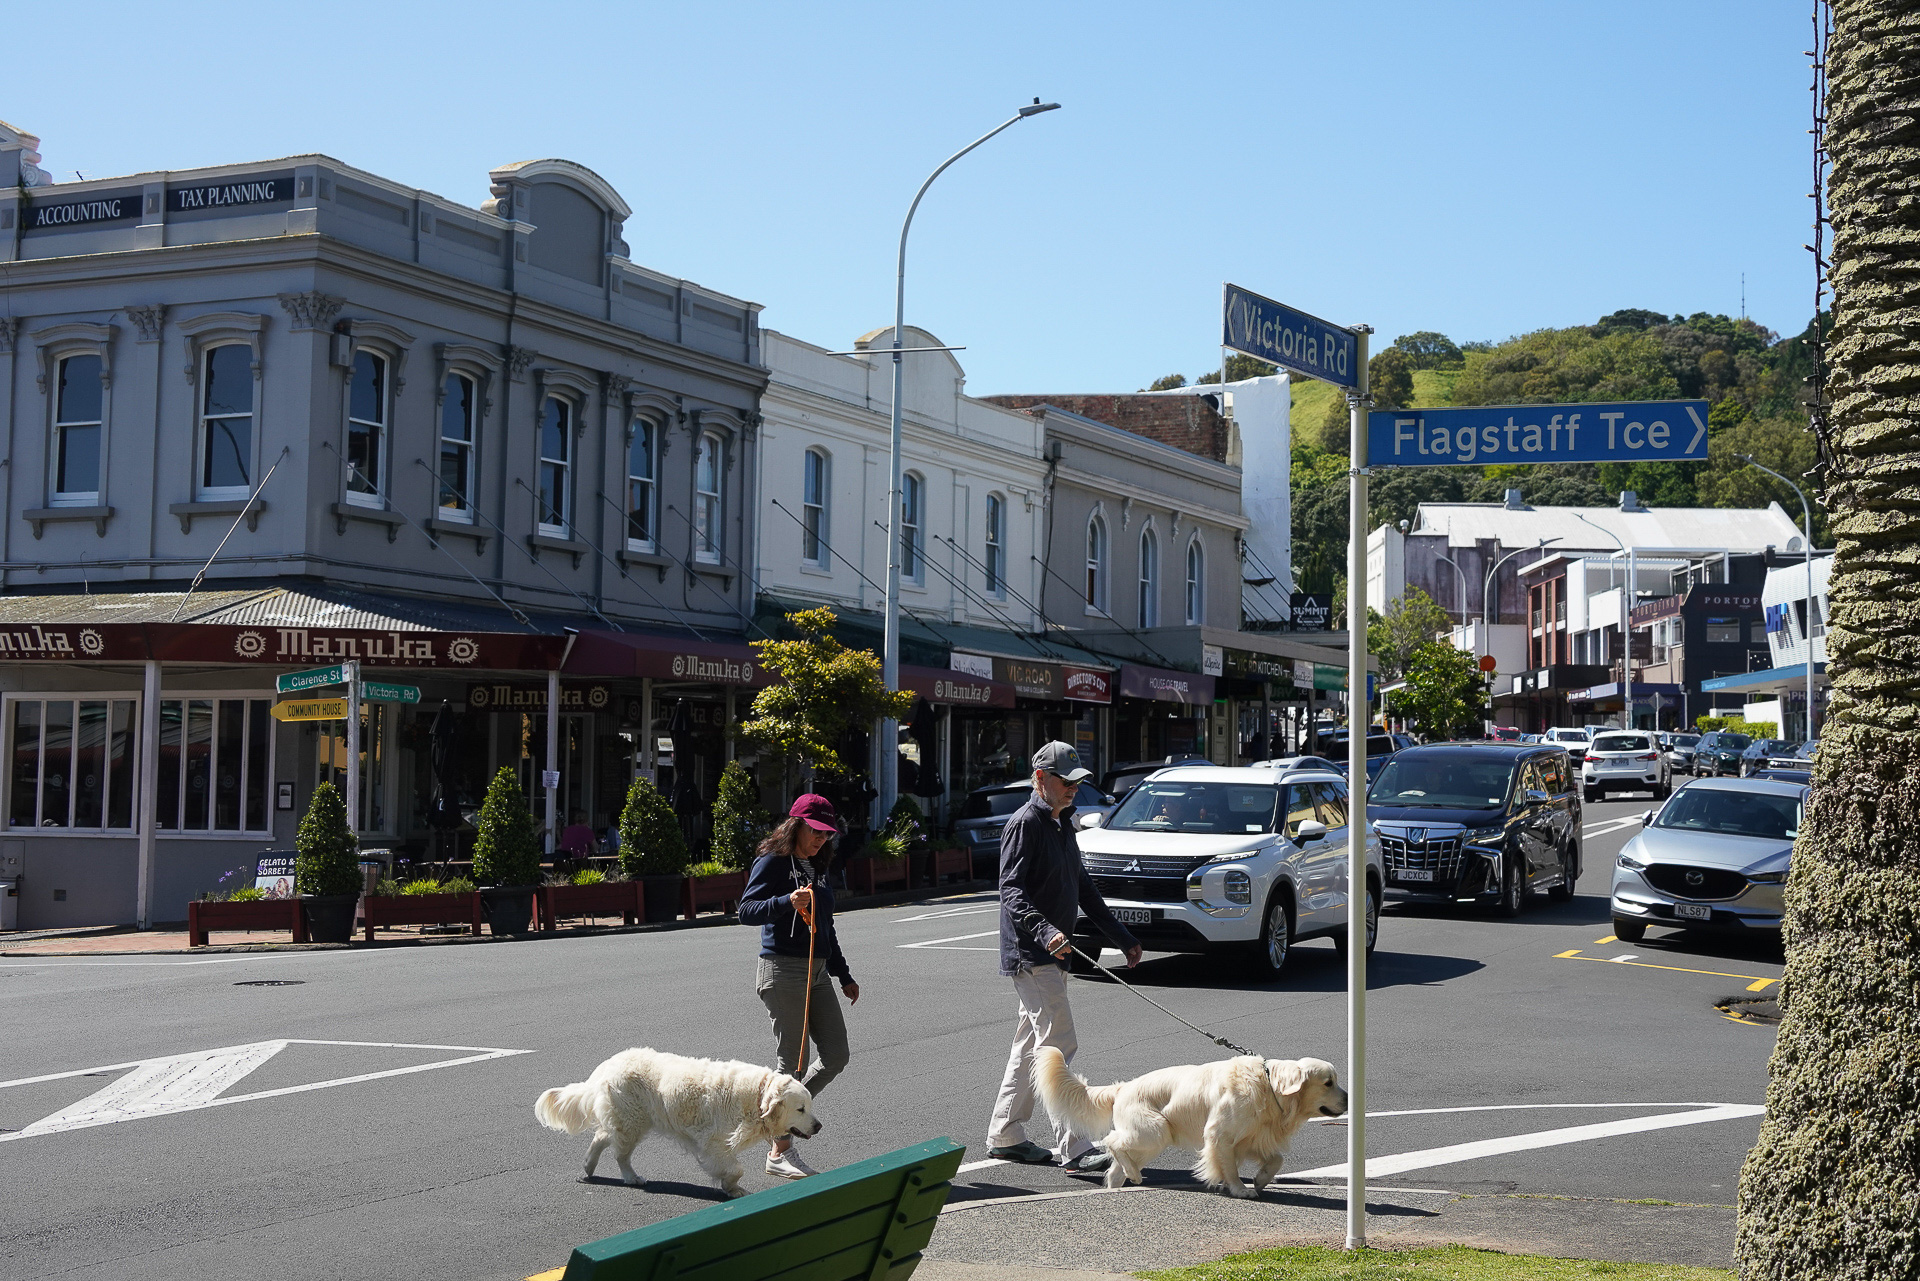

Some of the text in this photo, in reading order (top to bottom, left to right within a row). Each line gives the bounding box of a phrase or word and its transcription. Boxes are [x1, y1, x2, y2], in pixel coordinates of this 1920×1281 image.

[179, 181, 275, 208] TAX PLANNING
[36, 199, 121, 226] ACCOUNTING
[1242, 301, 1348, 377] Victoria Rd
[1393, 412, 1671, 462] Flagstaff Tce
[1292, 606, 1329, 616] SUMMIT
[276, 628, 436, 659] Manuka
[686, 655, 740, 679] Manuka
[1006, 664, 1052, 686] VIC ROAD
[1257, 661, 1283, 676] KITCHEN
[291, 670, 340, 688] Clarence St
[1067, 672, 1107, 693] DIRECTOR'S CUT
[1173, 680, 1189, 692] TRAVEL
[368, 685, 414, 700] Victoria Rd
[945, 681, 982, 700] Manuka
[288, 702, 342, 717] COMMUNITY HOUSE
[259, 857, 296, 867] GELATO &
[257, 867, 287, 876] SORBET
[1402, 871, 1429, 880] JCXCC
[1677, 905, 1707, 917] NLS87
